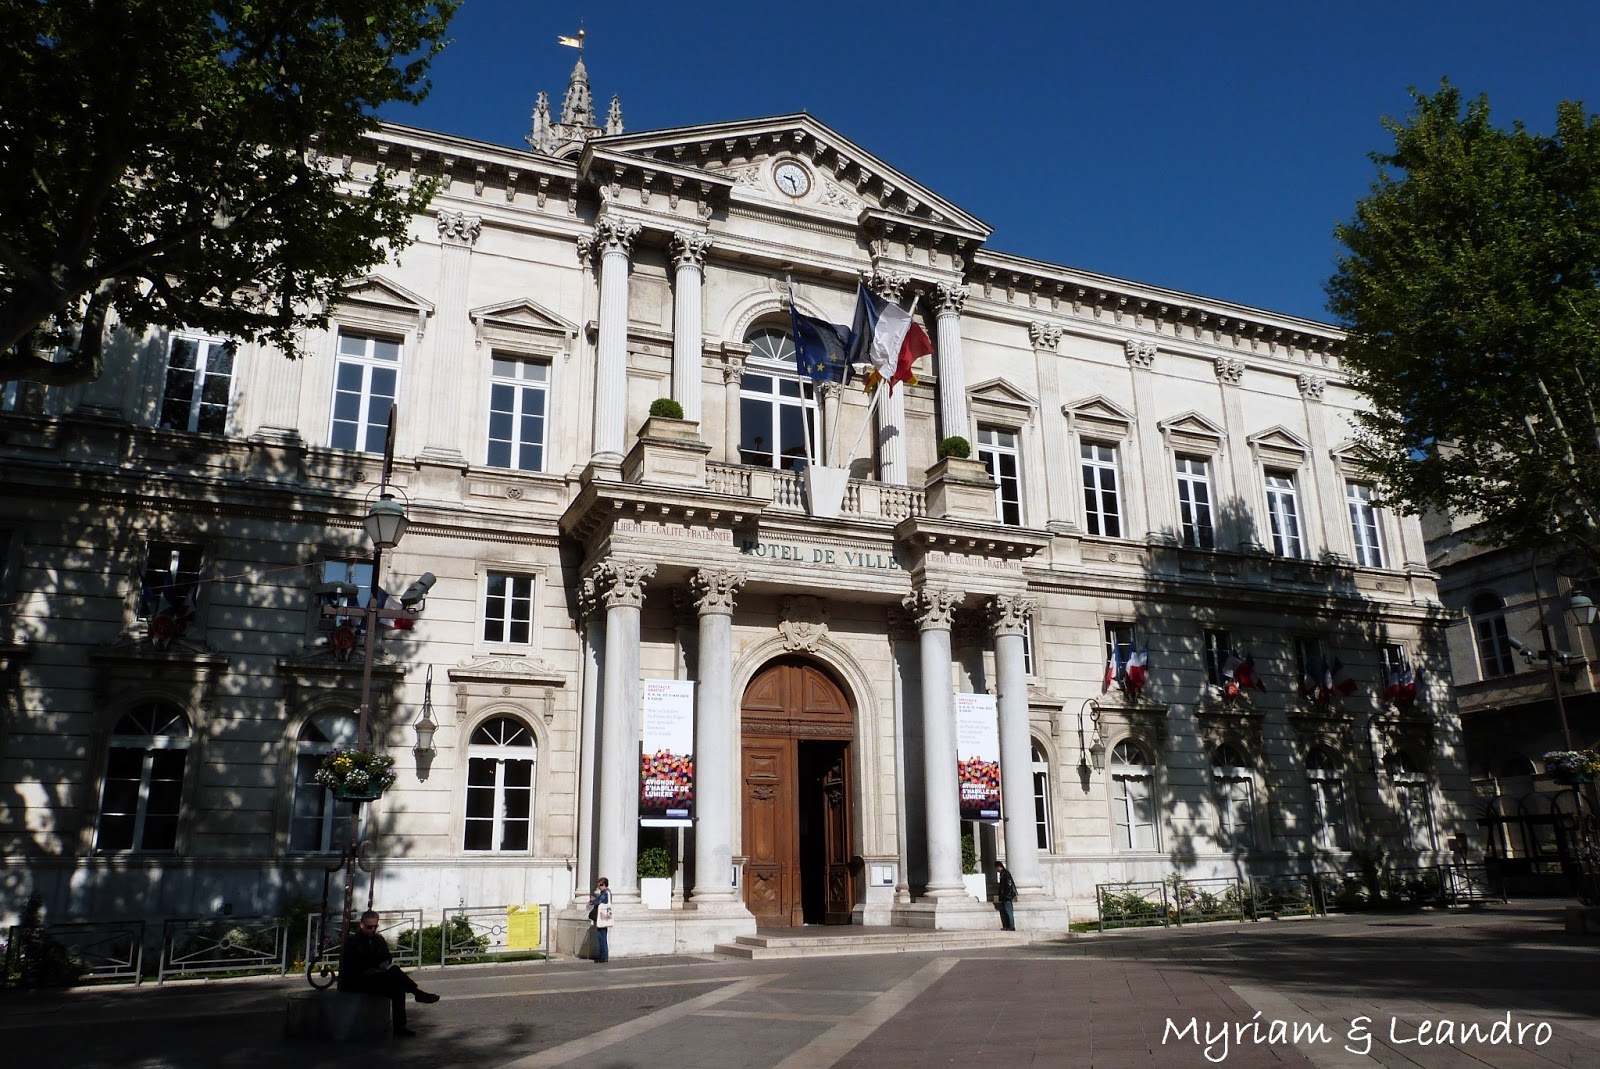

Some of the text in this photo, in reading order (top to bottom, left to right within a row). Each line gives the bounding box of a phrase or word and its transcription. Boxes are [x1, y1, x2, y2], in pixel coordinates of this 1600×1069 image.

[742, 540, 899, 569] HOTEL DE VILLE
